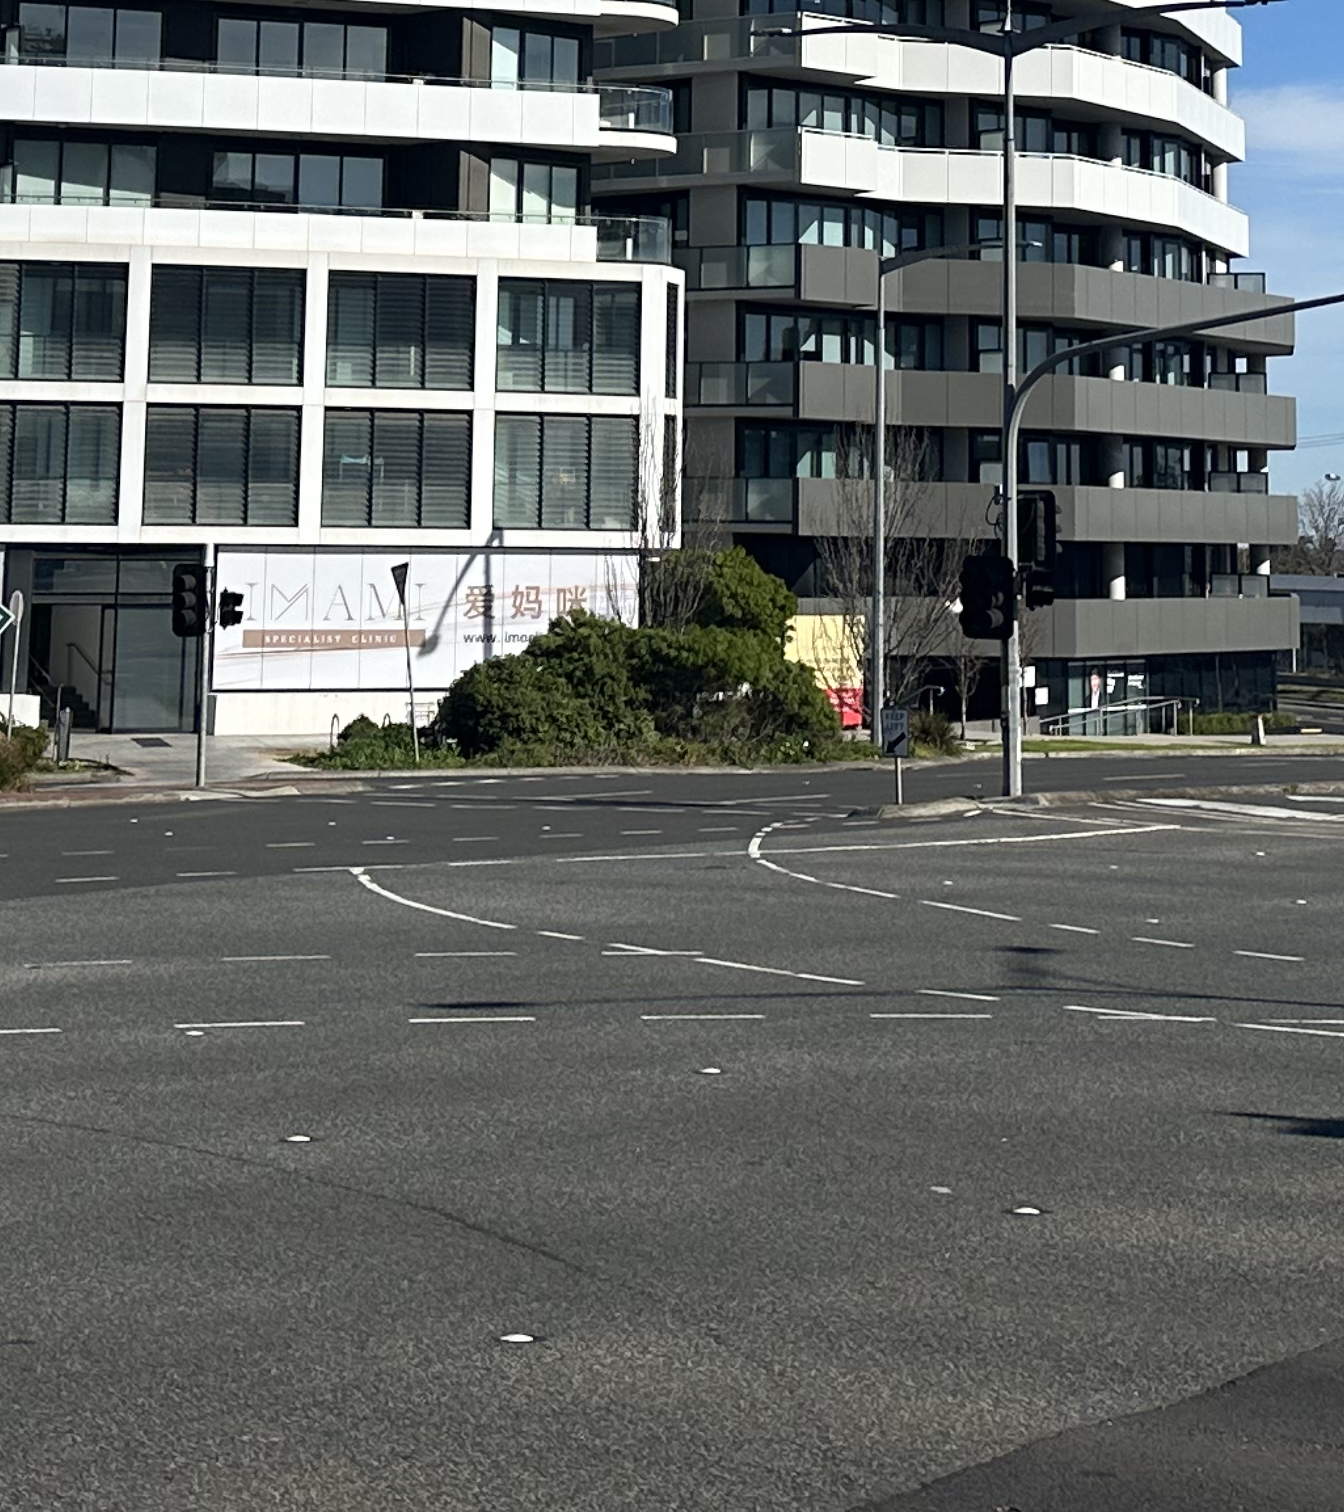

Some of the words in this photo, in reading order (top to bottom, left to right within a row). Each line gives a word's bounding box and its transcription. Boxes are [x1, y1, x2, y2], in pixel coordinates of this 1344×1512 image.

[245, 582, 426, 621] IMAMI
[264, 634, 342, 644] SPECIALIST
[351, 634, 397, 643] CLINIC
